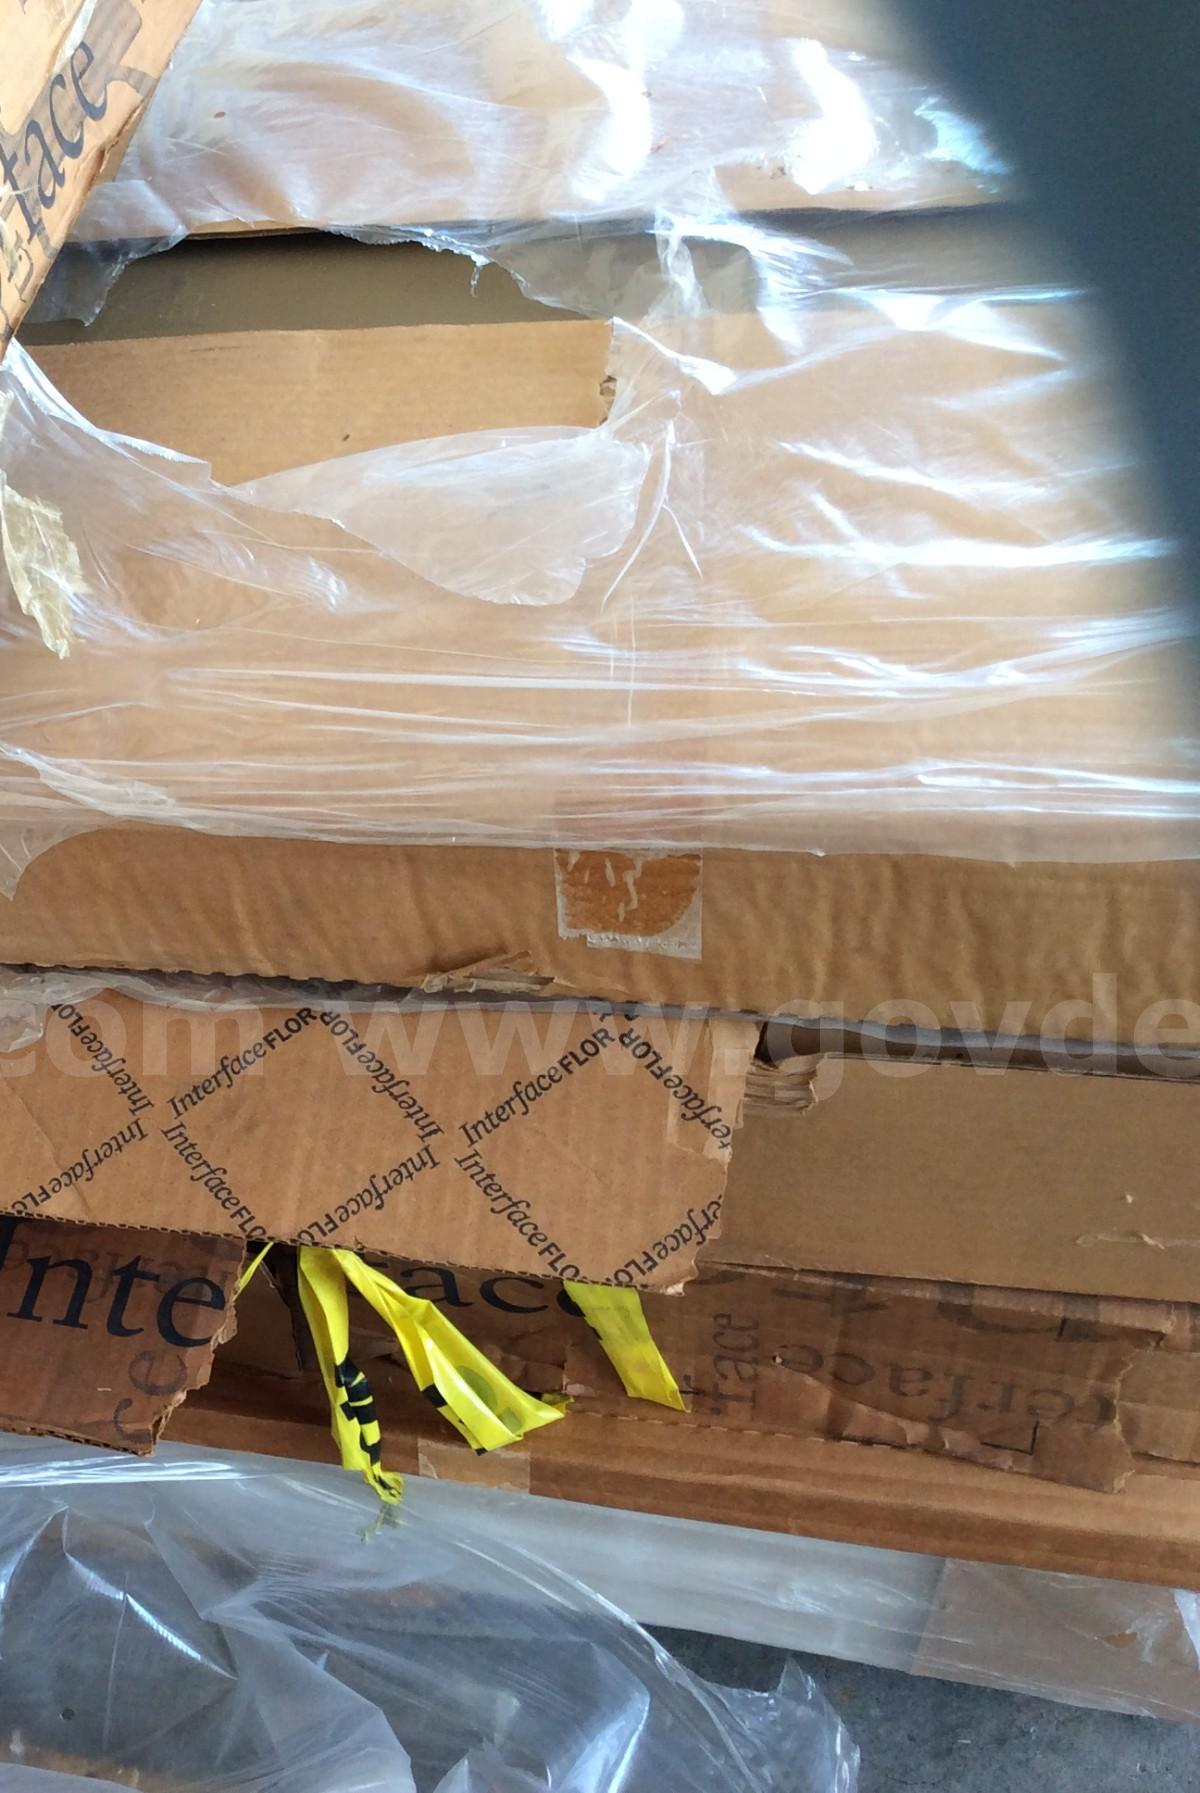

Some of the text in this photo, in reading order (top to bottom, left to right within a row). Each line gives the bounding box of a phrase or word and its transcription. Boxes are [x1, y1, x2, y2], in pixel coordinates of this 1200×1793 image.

[166, 1006, 317, 1121] InterfaceFLOR
[319, 1010, 445, 1143] InterfaceFLOR
[457, 1026, 616, 1149] InterfaceFLOR
